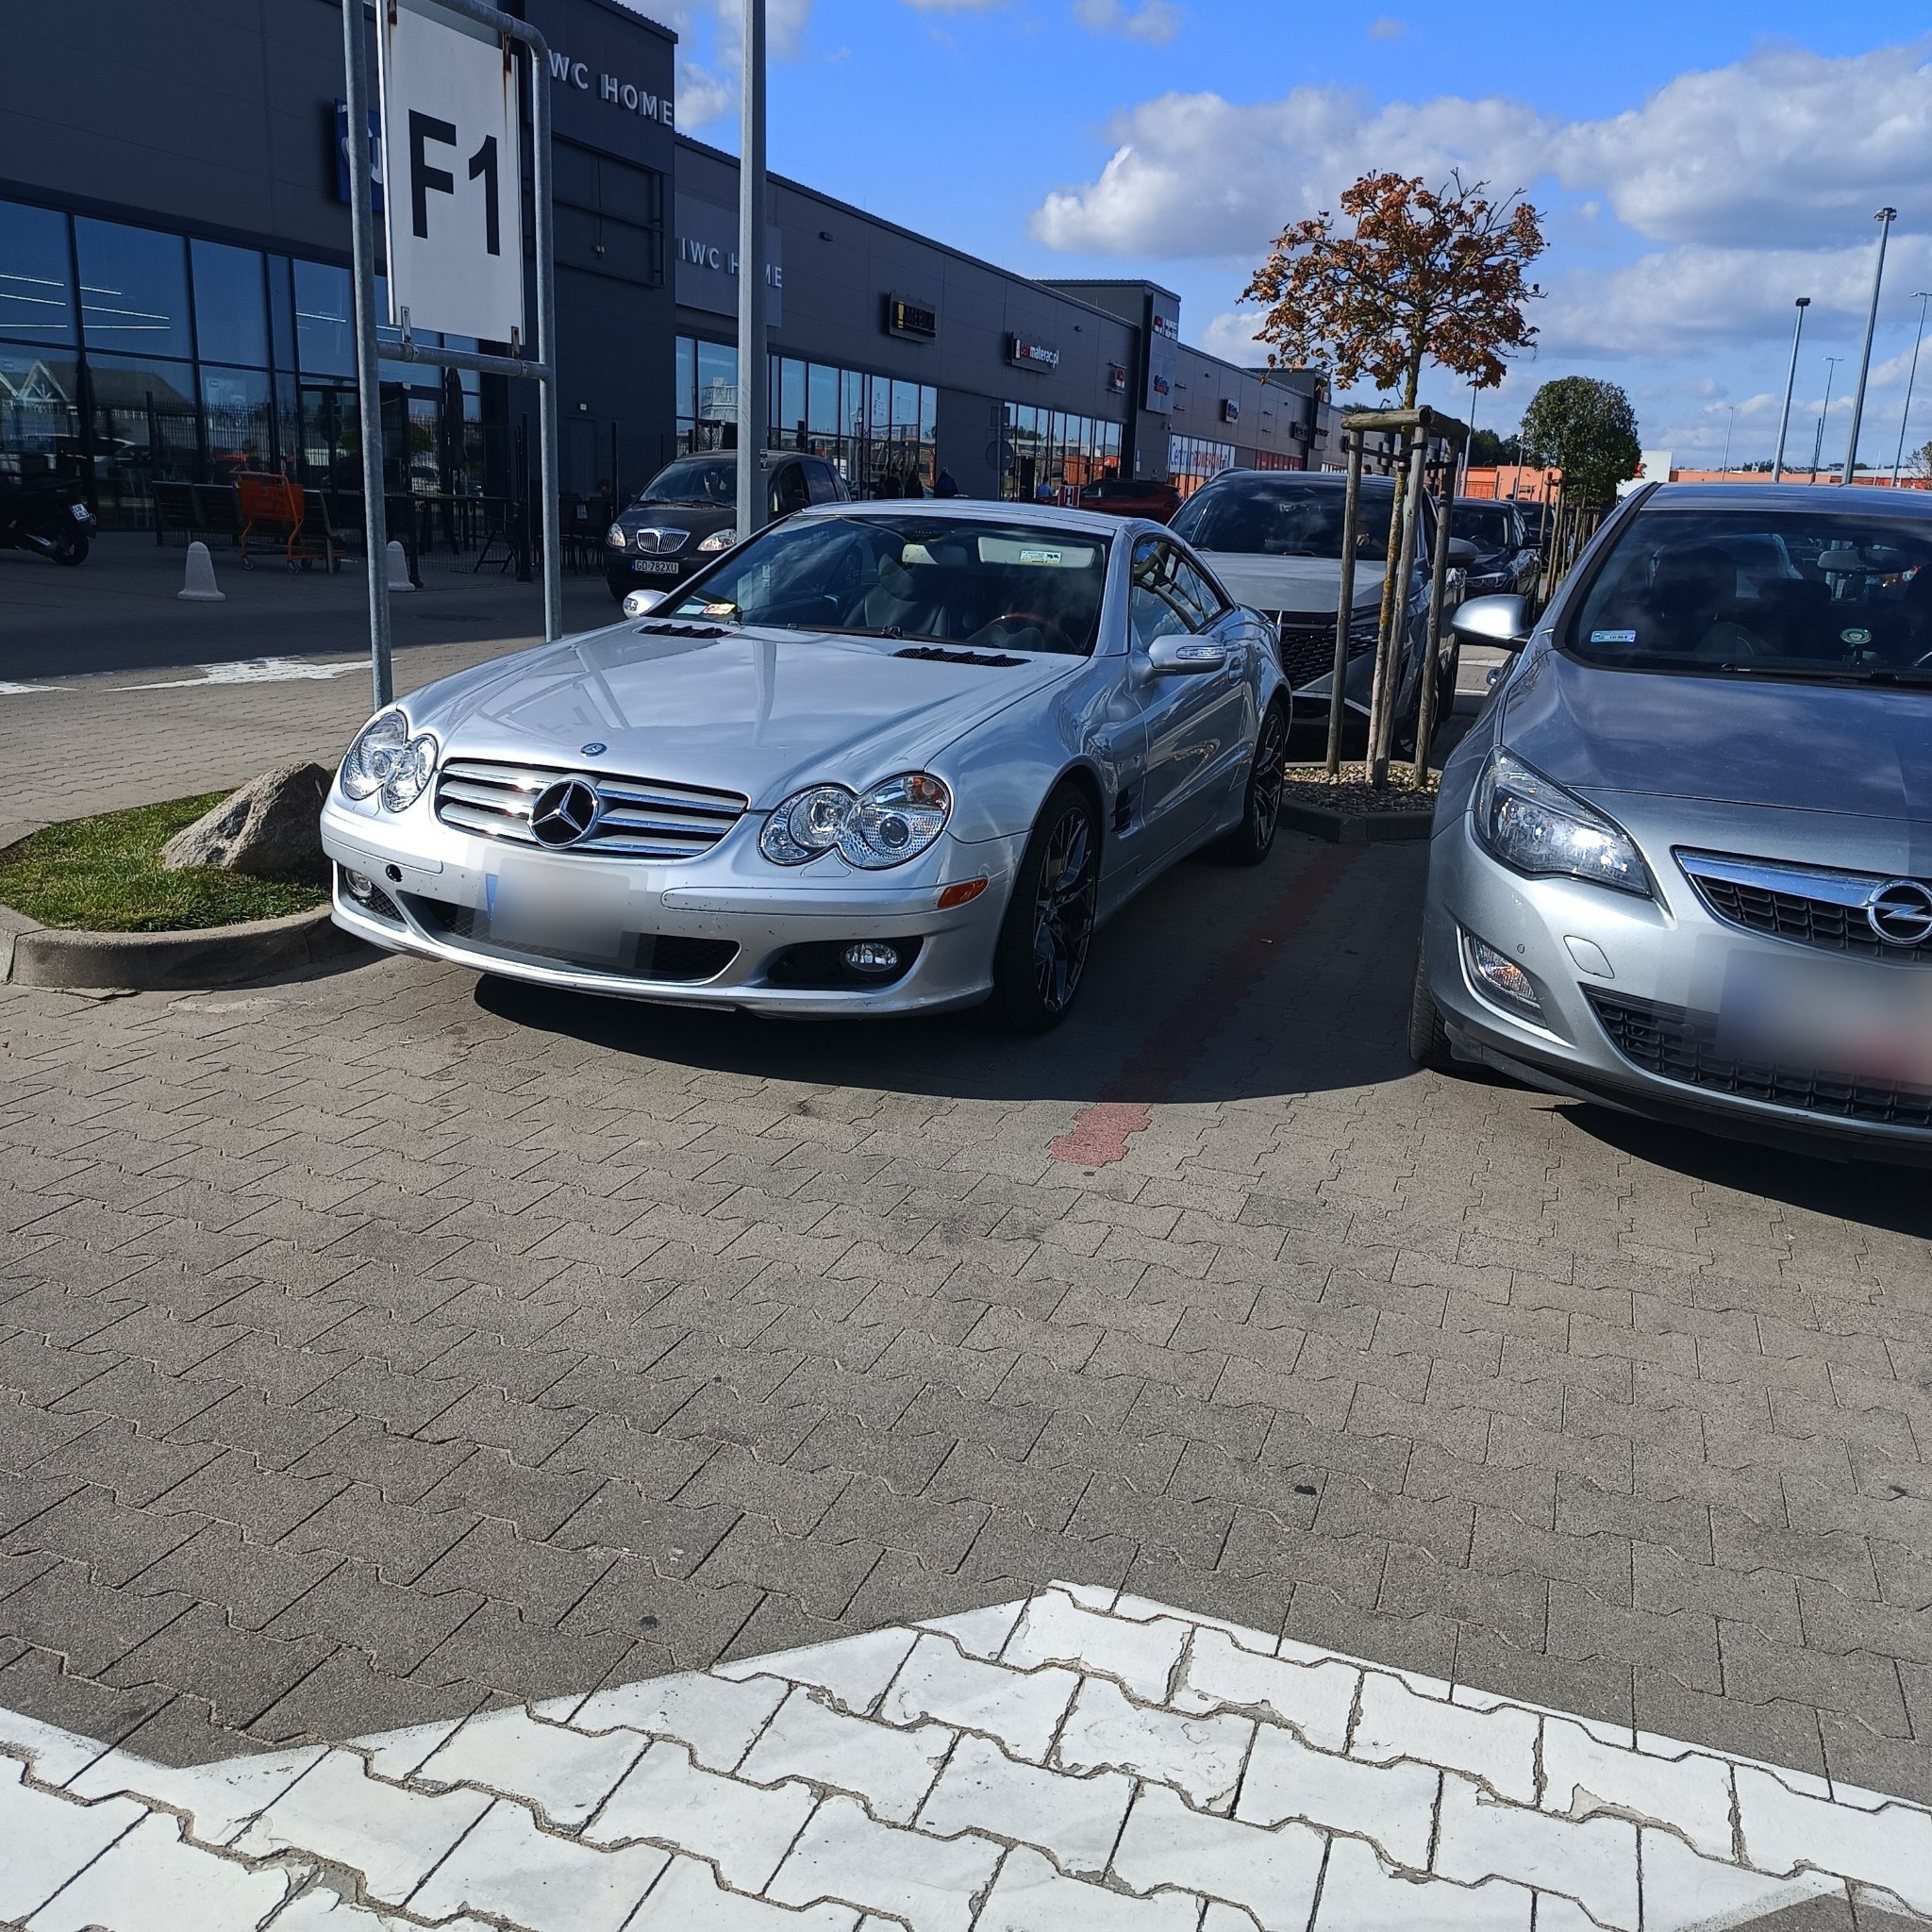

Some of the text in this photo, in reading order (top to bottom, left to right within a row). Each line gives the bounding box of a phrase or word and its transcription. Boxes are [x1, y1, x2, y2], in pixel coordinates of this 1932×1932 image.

[548, 49, 673, 126] WC HOME
[408, 108, 501, 257] F1
[682, 238, 783, 288] IWC HE
[636, 560, 677, 573] GD 782XU
